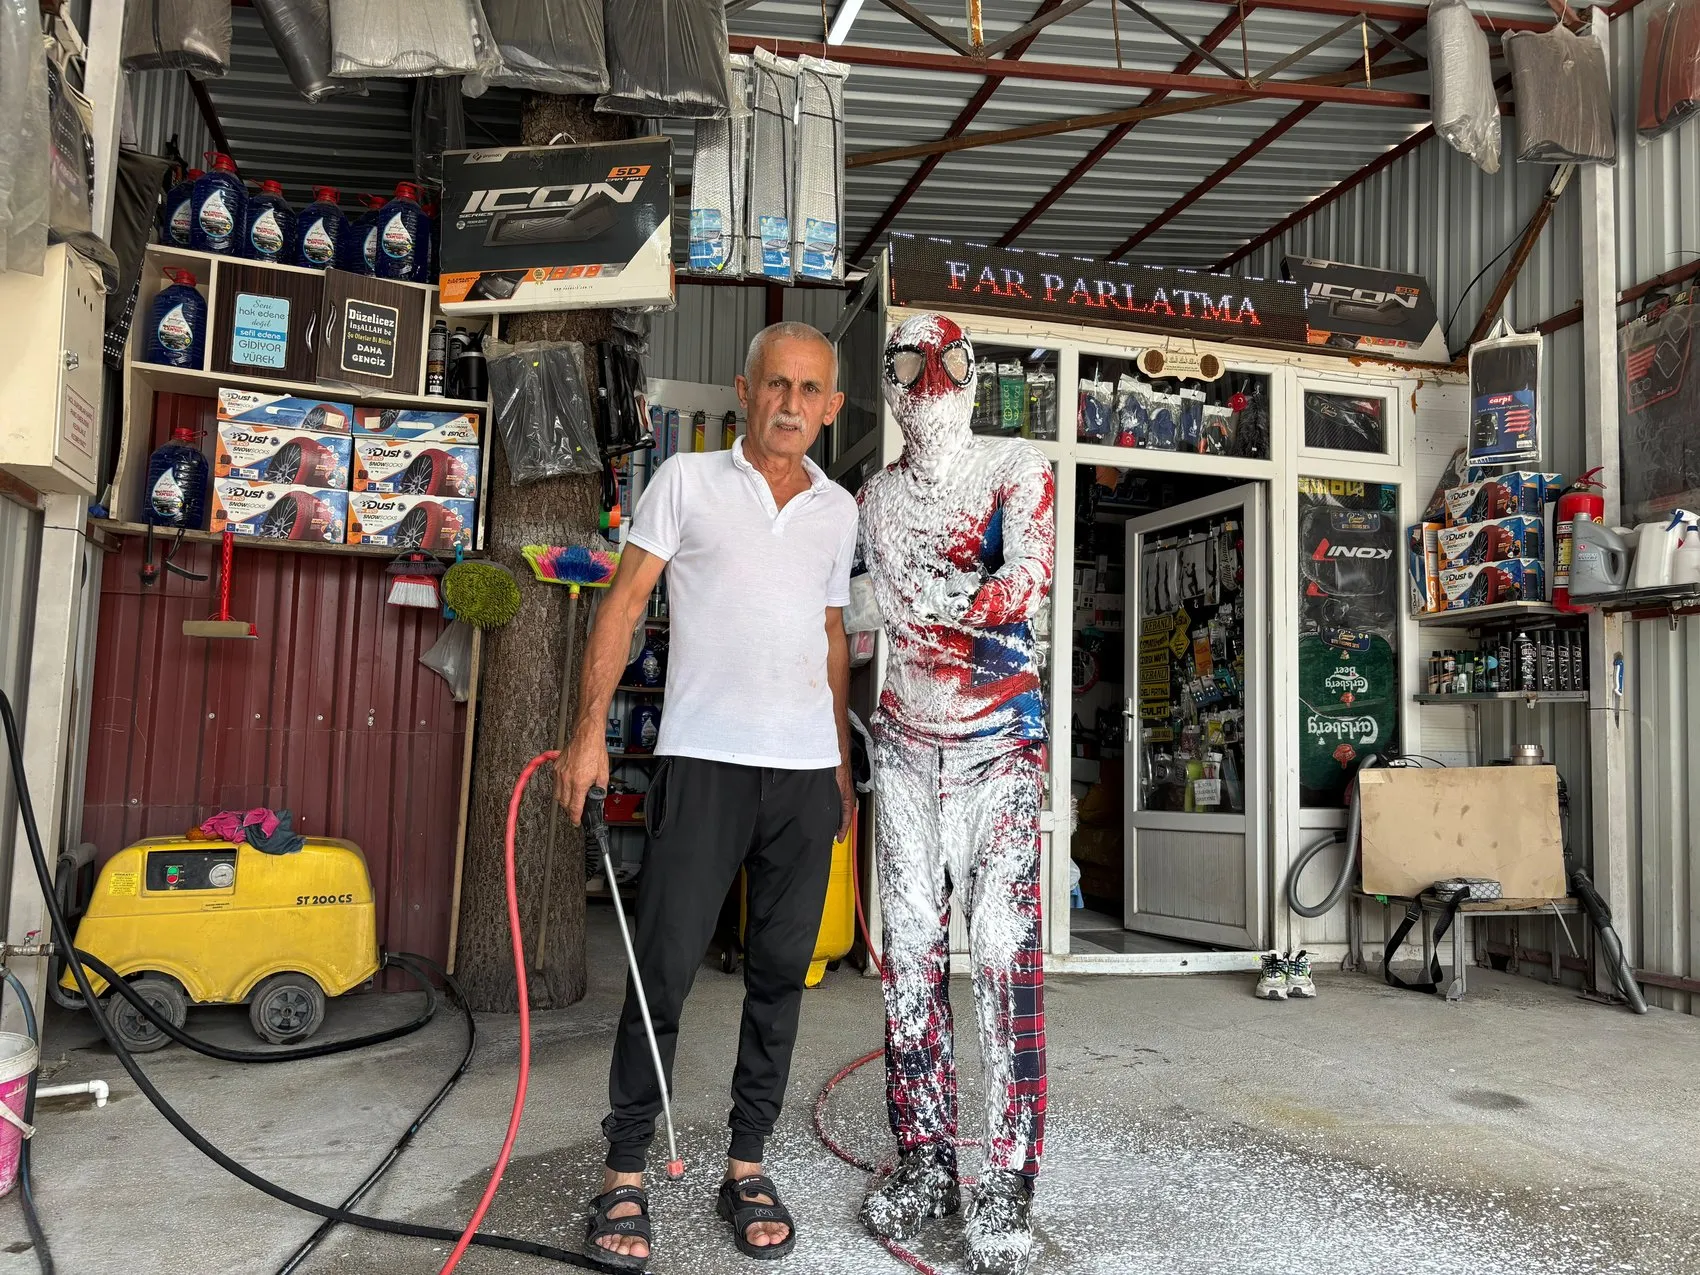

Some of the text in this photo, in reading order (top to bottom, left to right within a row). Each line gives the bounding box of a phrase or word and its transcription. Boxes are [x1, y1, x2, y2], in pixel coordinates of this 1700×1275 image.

[614, 167, 641, 176] 5D
[461, 181, 644, 213] ICON
[946, 260, 1261, 325] FAR PARLATMA
[1309, 282, 1418, 308] ICON
[253, 299, 272, 310] Seni
[239, 307, 285, 320] hak edene
[348, 309, 395, 328] Düzelicez
[240, 328, 281, 340] sefil edene
[383, 328, 392, 336] be
[357, 343, 382, 355] DAHA
[243, 351, 275, 364] YÜREK
[352, 353, 386, 367] GENCİZ
[229, 391, 251, 401] Dust
[1489, 396, 1511, 405] carpi
[236, 432, 269, 444] Dust
[232, 446, 270, 455] SNOWSOCKS
[373, 448, 402, 458] Dust
[232, 487, 265, 499] Dust
[1453, 489, 1470, 499] Dust
[228, 501, 266, 509] SNOWSOCKS
[367, 500, 396, 510] Dust
[1448, 531, 1467, 541] Dust
[1326, 546, 1393, 560] KONI
[1448, 572, 1467, 581] Dust
[1334, 667, 1357, 677] Beer
[1325, 675, 1369, 693] Carlsberg
[1307, 715, 1378, 744] Carlsberg
[296, 894, 353, 905] ST 200 CS
